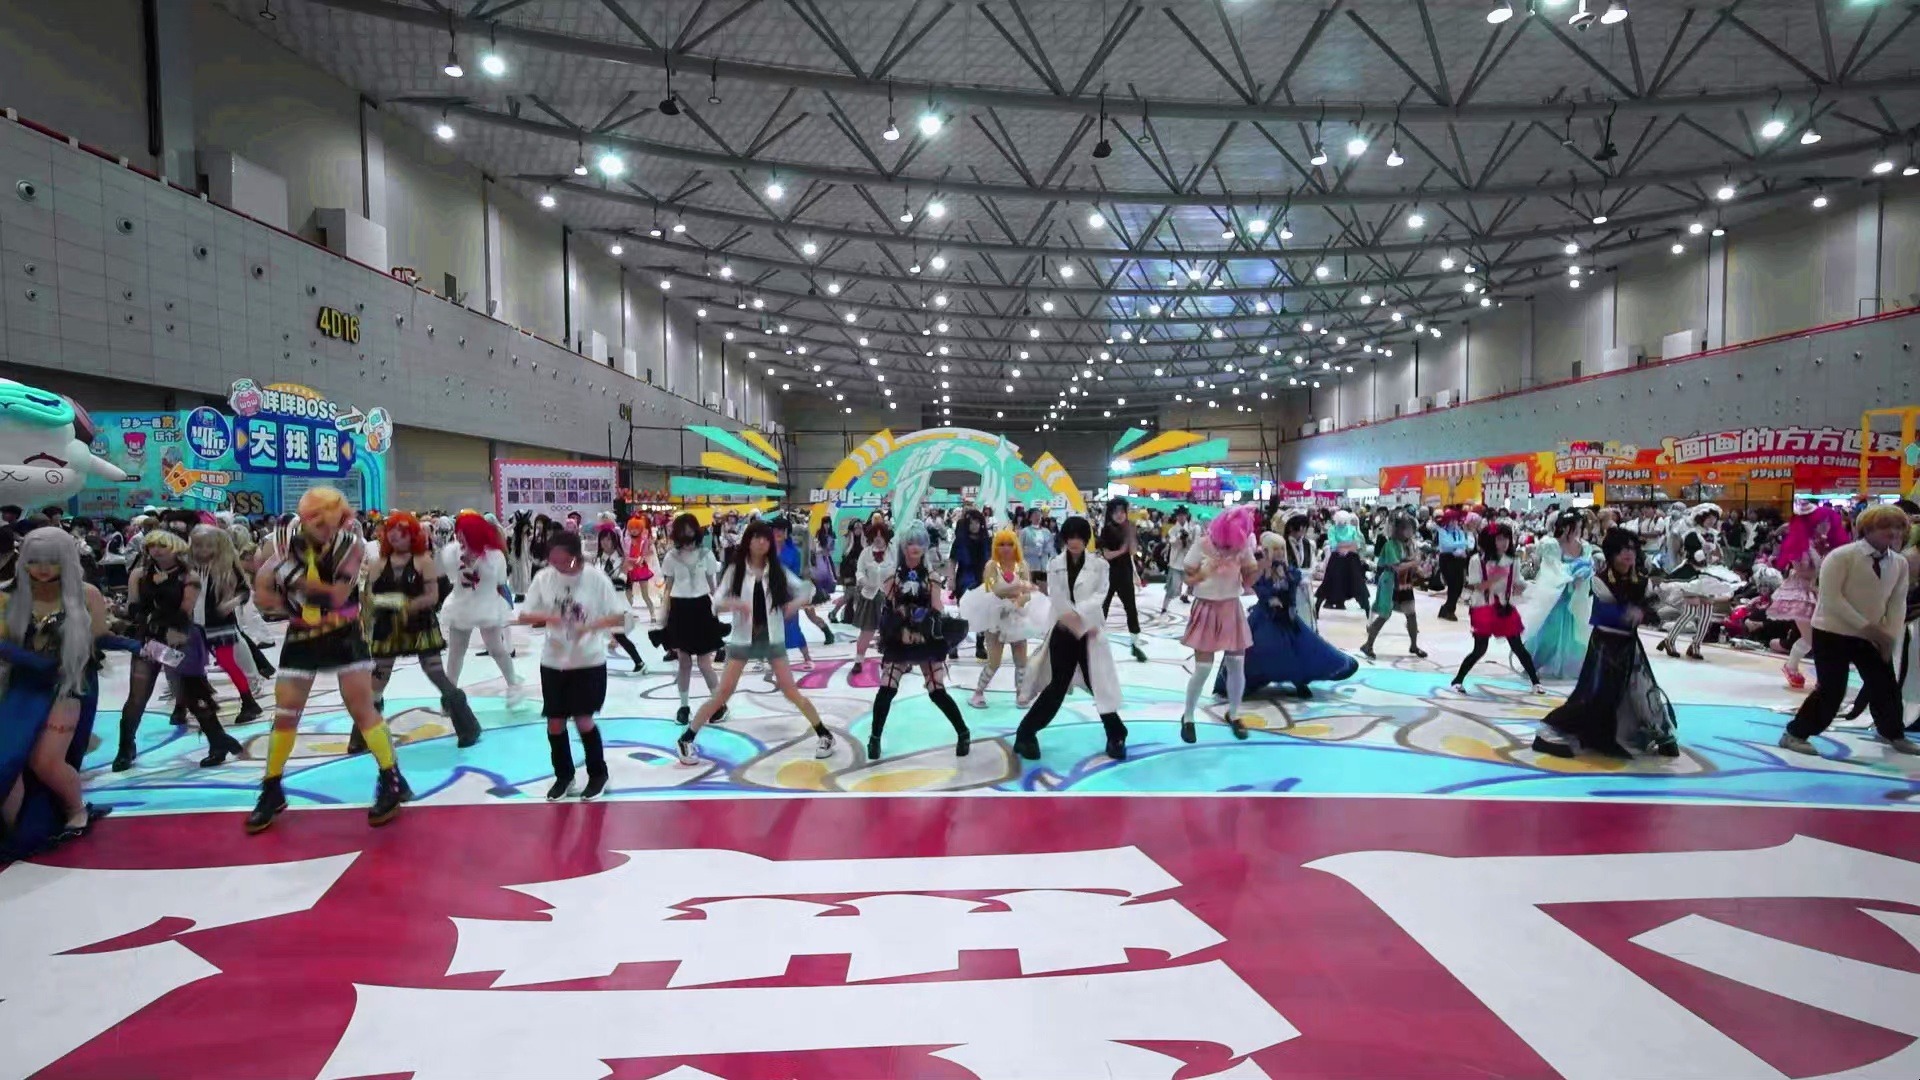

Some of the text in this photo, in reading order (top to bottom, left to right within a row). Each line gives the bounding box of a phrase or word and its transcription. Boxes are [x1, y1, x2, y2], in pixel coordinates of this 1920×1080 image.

[319, 307, 360, 344] 4D16
[263, 390, 338, 421] 咩咩BOSS
[251, 426, 338, 462] 大挑战
